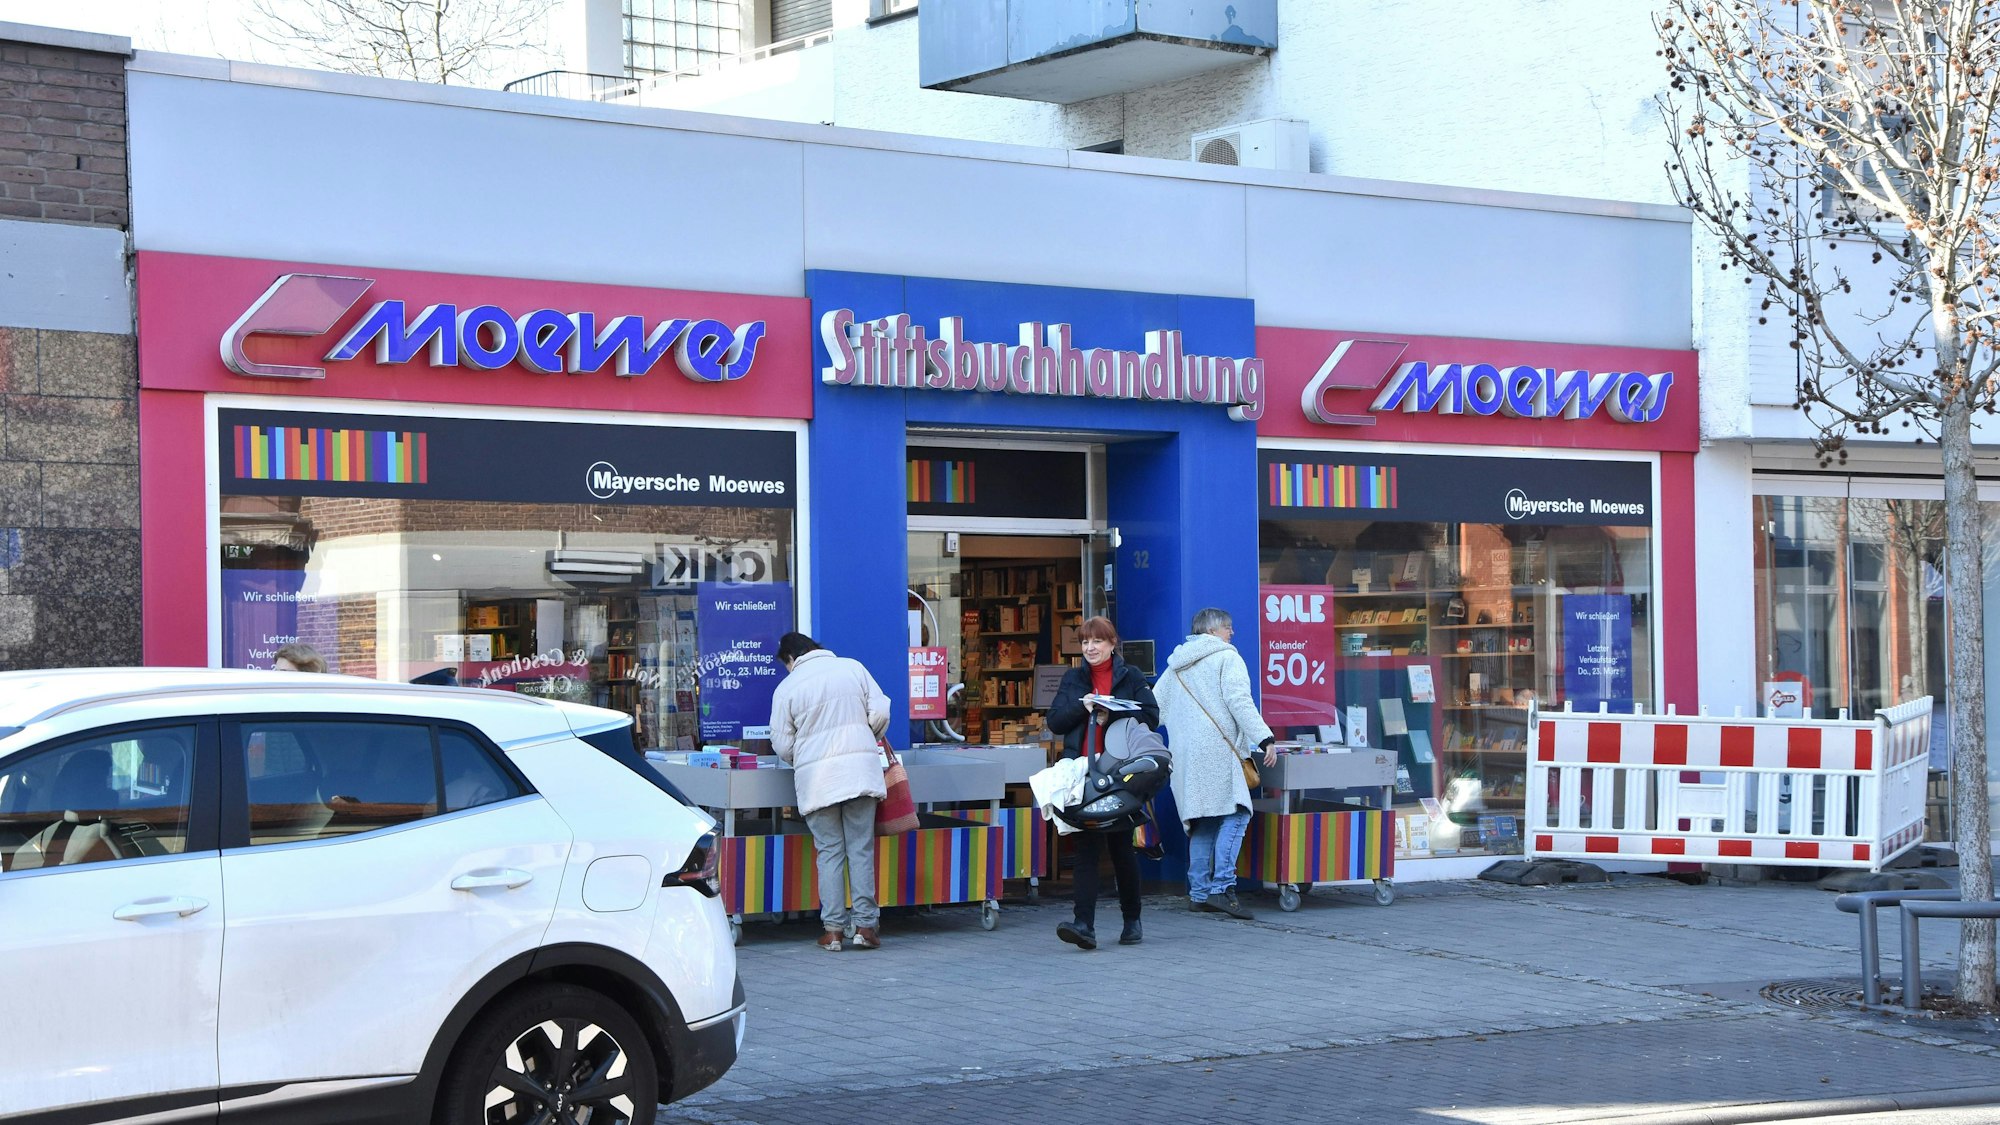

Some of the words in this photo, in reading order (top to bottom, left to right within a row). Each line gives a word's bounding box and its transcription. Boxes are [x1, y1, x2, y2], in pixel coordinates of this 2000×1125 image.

[820, 308, 1265, 422] Stiftsbuchhandlung
[593, 471, 700, 495] Mayersche
[709, 474, 786, 495] Moewes
[1510, 496, 1584, 516] Mayersche
[1590, 498, 1645, 516] Moewes
[1133, 550, 1150, 569] 32
[243, 592, 262, 602] Wir
[715, 601, 731, 611] Wir
[733, 601, 776, 611] schließen!
[1265, 594, 1326, 623] SALE
[1576, 612, 1588, 620] Wir
[1588, 611, 1620, 620] schließen!
[263, 634, 300, 644] Letzter
[731, 640, 762, 649] Letzter
[1587, 644, 1609, 653] Letzter
[720, 654, 773, 664] Verkaufstag:
[1579, 656, 1617, 665] Verkaufstag:
[738, 667, 752, 676] 23.
[754, 667, 776, 676] März
[1603, 667, 1619, 675] März
